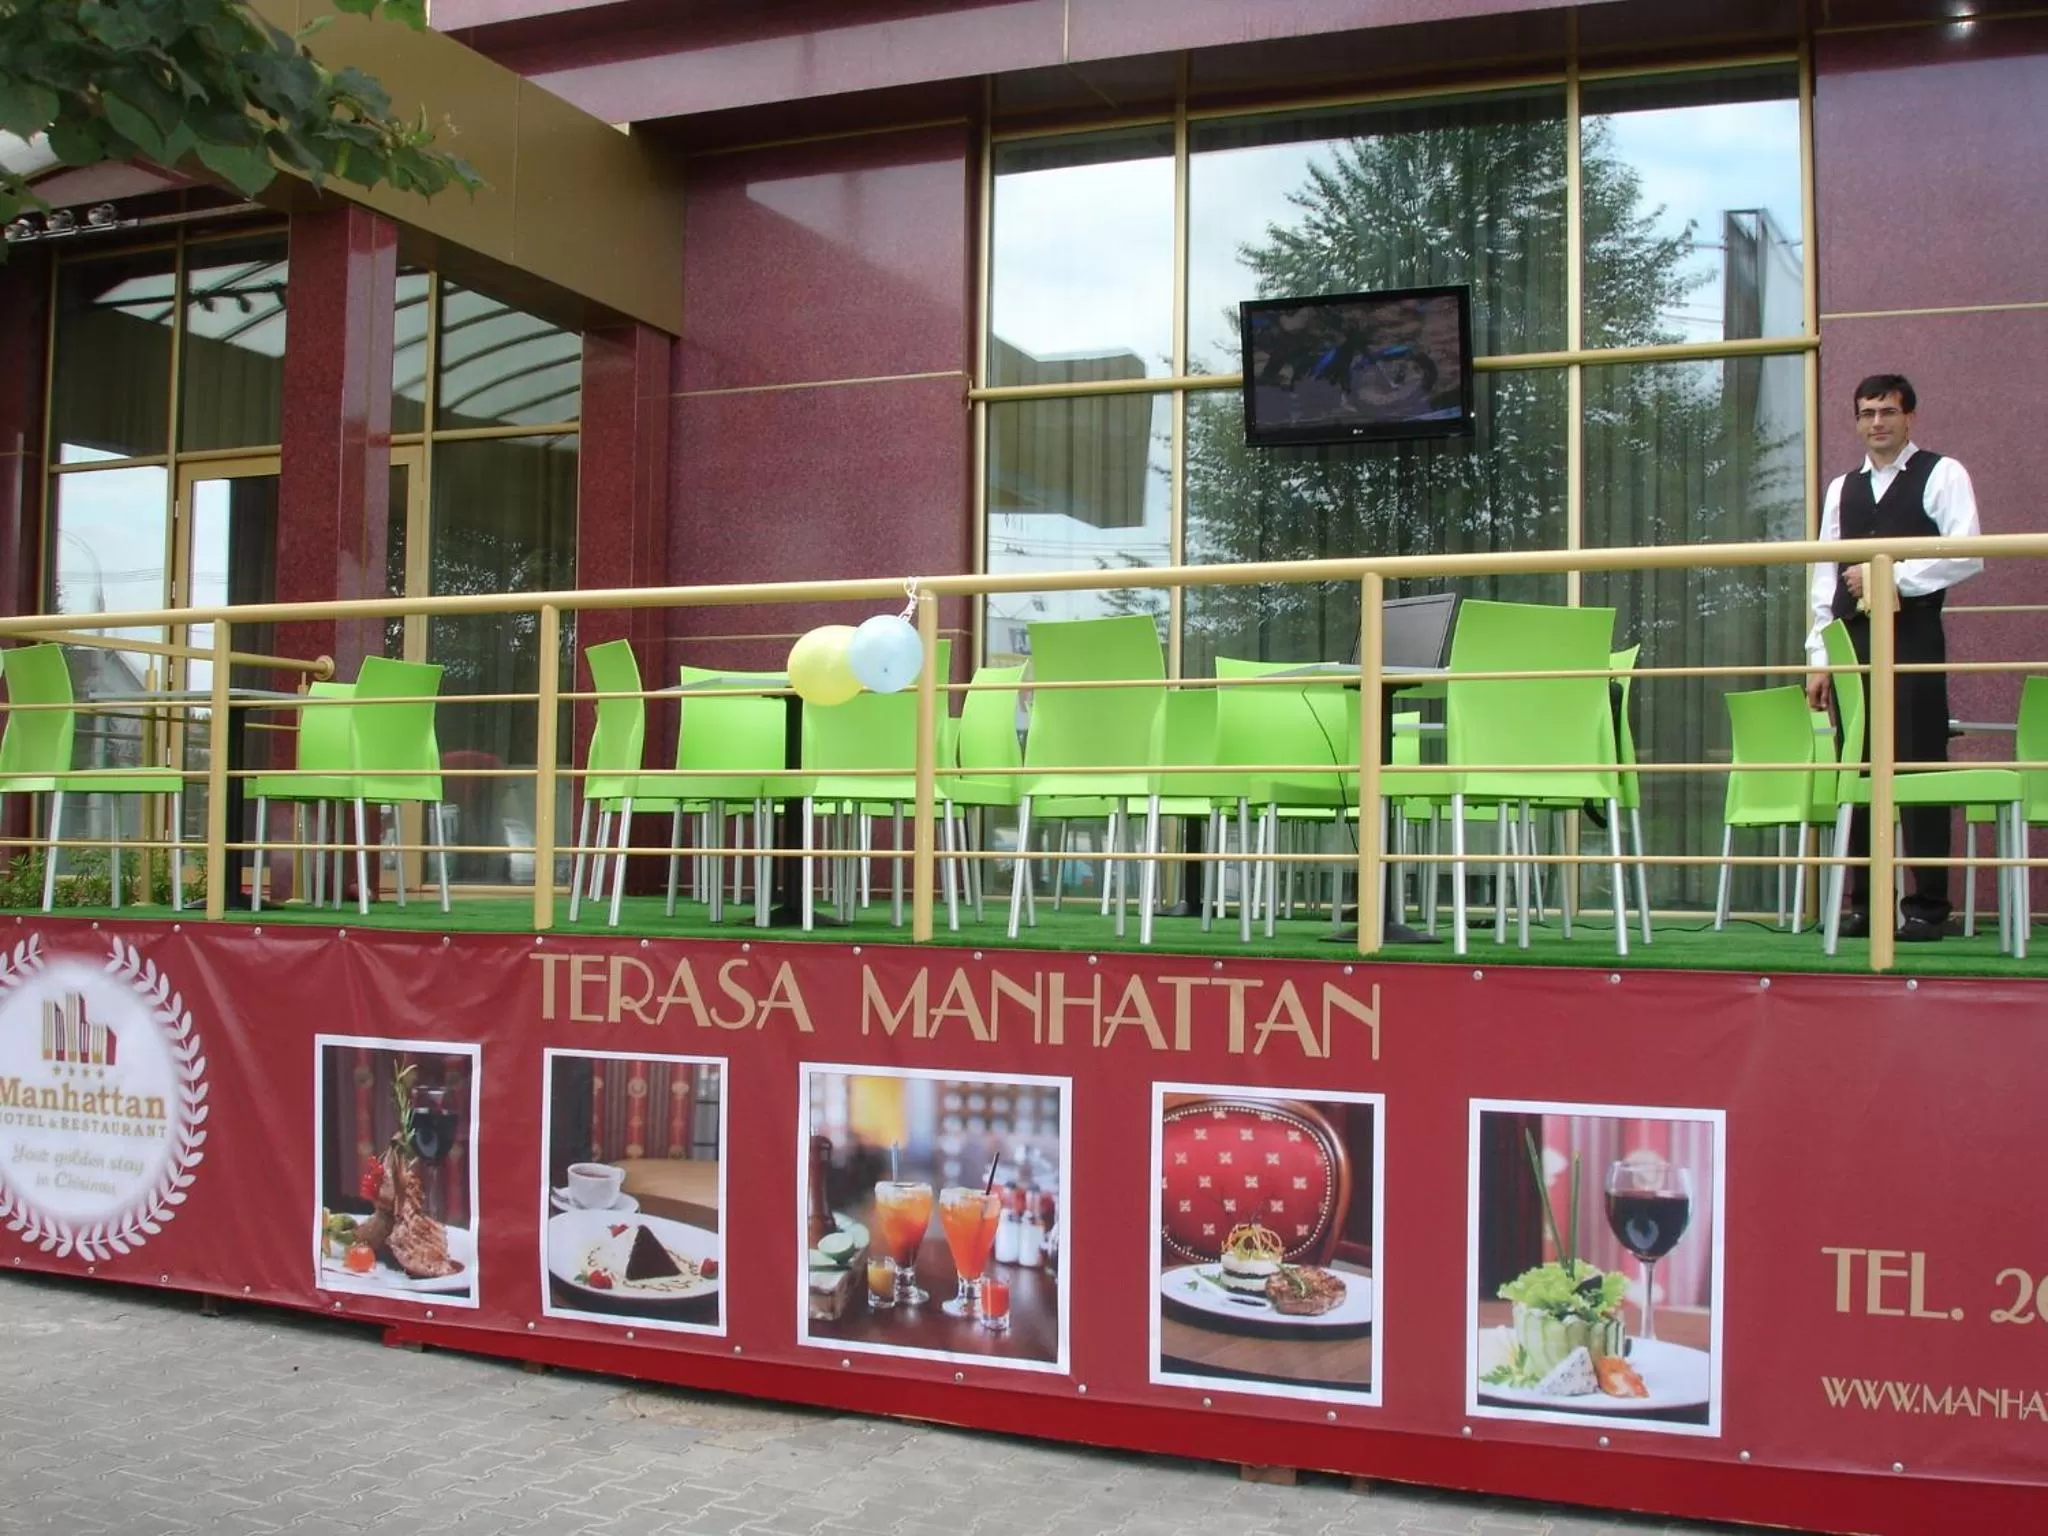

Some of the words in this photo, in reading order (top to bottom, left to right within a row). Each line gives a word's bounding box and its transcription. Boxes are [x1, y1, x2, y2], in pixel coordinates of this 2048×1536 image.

[529, 953, 814, 1032] TERASA
[862, 964, 1380, 1060] MANHATTAN
[0, 1076, 166, 1120] Manhattan
[0, 1111, 44, 1127] OTEL
[62, 1117, 166, 1138] RESTAURANT
[1821, 1247, 1965, 1321] TEL.
[1820, 1376, 2048, 1423] WWW.MANHA
